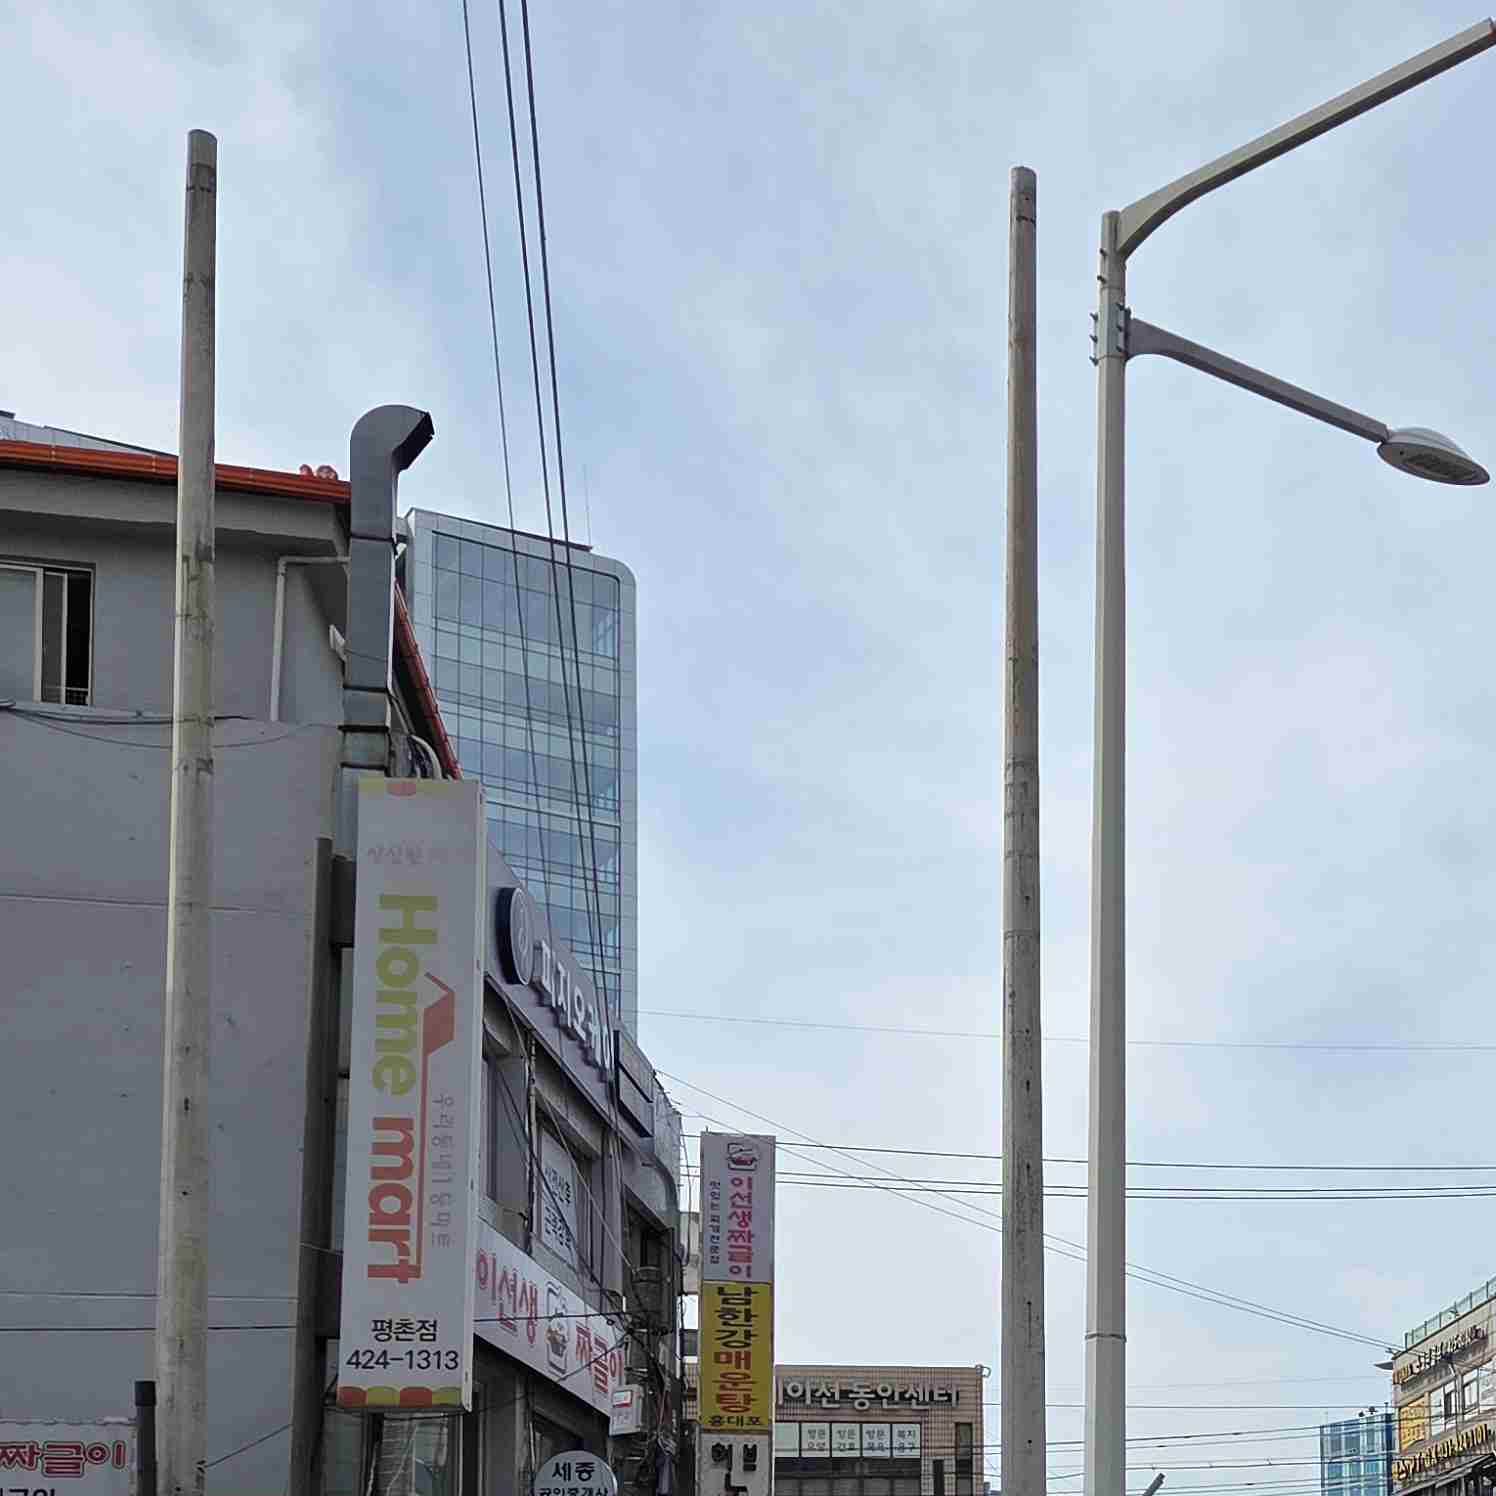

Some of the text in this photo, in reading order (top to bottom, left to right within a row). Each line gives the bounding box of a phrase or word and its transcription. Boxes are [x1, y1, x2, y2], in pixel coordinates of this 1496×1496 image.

[369, 892, 438, 1096] Home
[367, 1116, 420, 1284] mart
[372, 1318, 438, 1342] 평촌점
[346, 1350, 459, 1370] 424-1313
[848, 1378, 959, 1410] 동안센터
[552, 1461, 596, 1482] 세종
